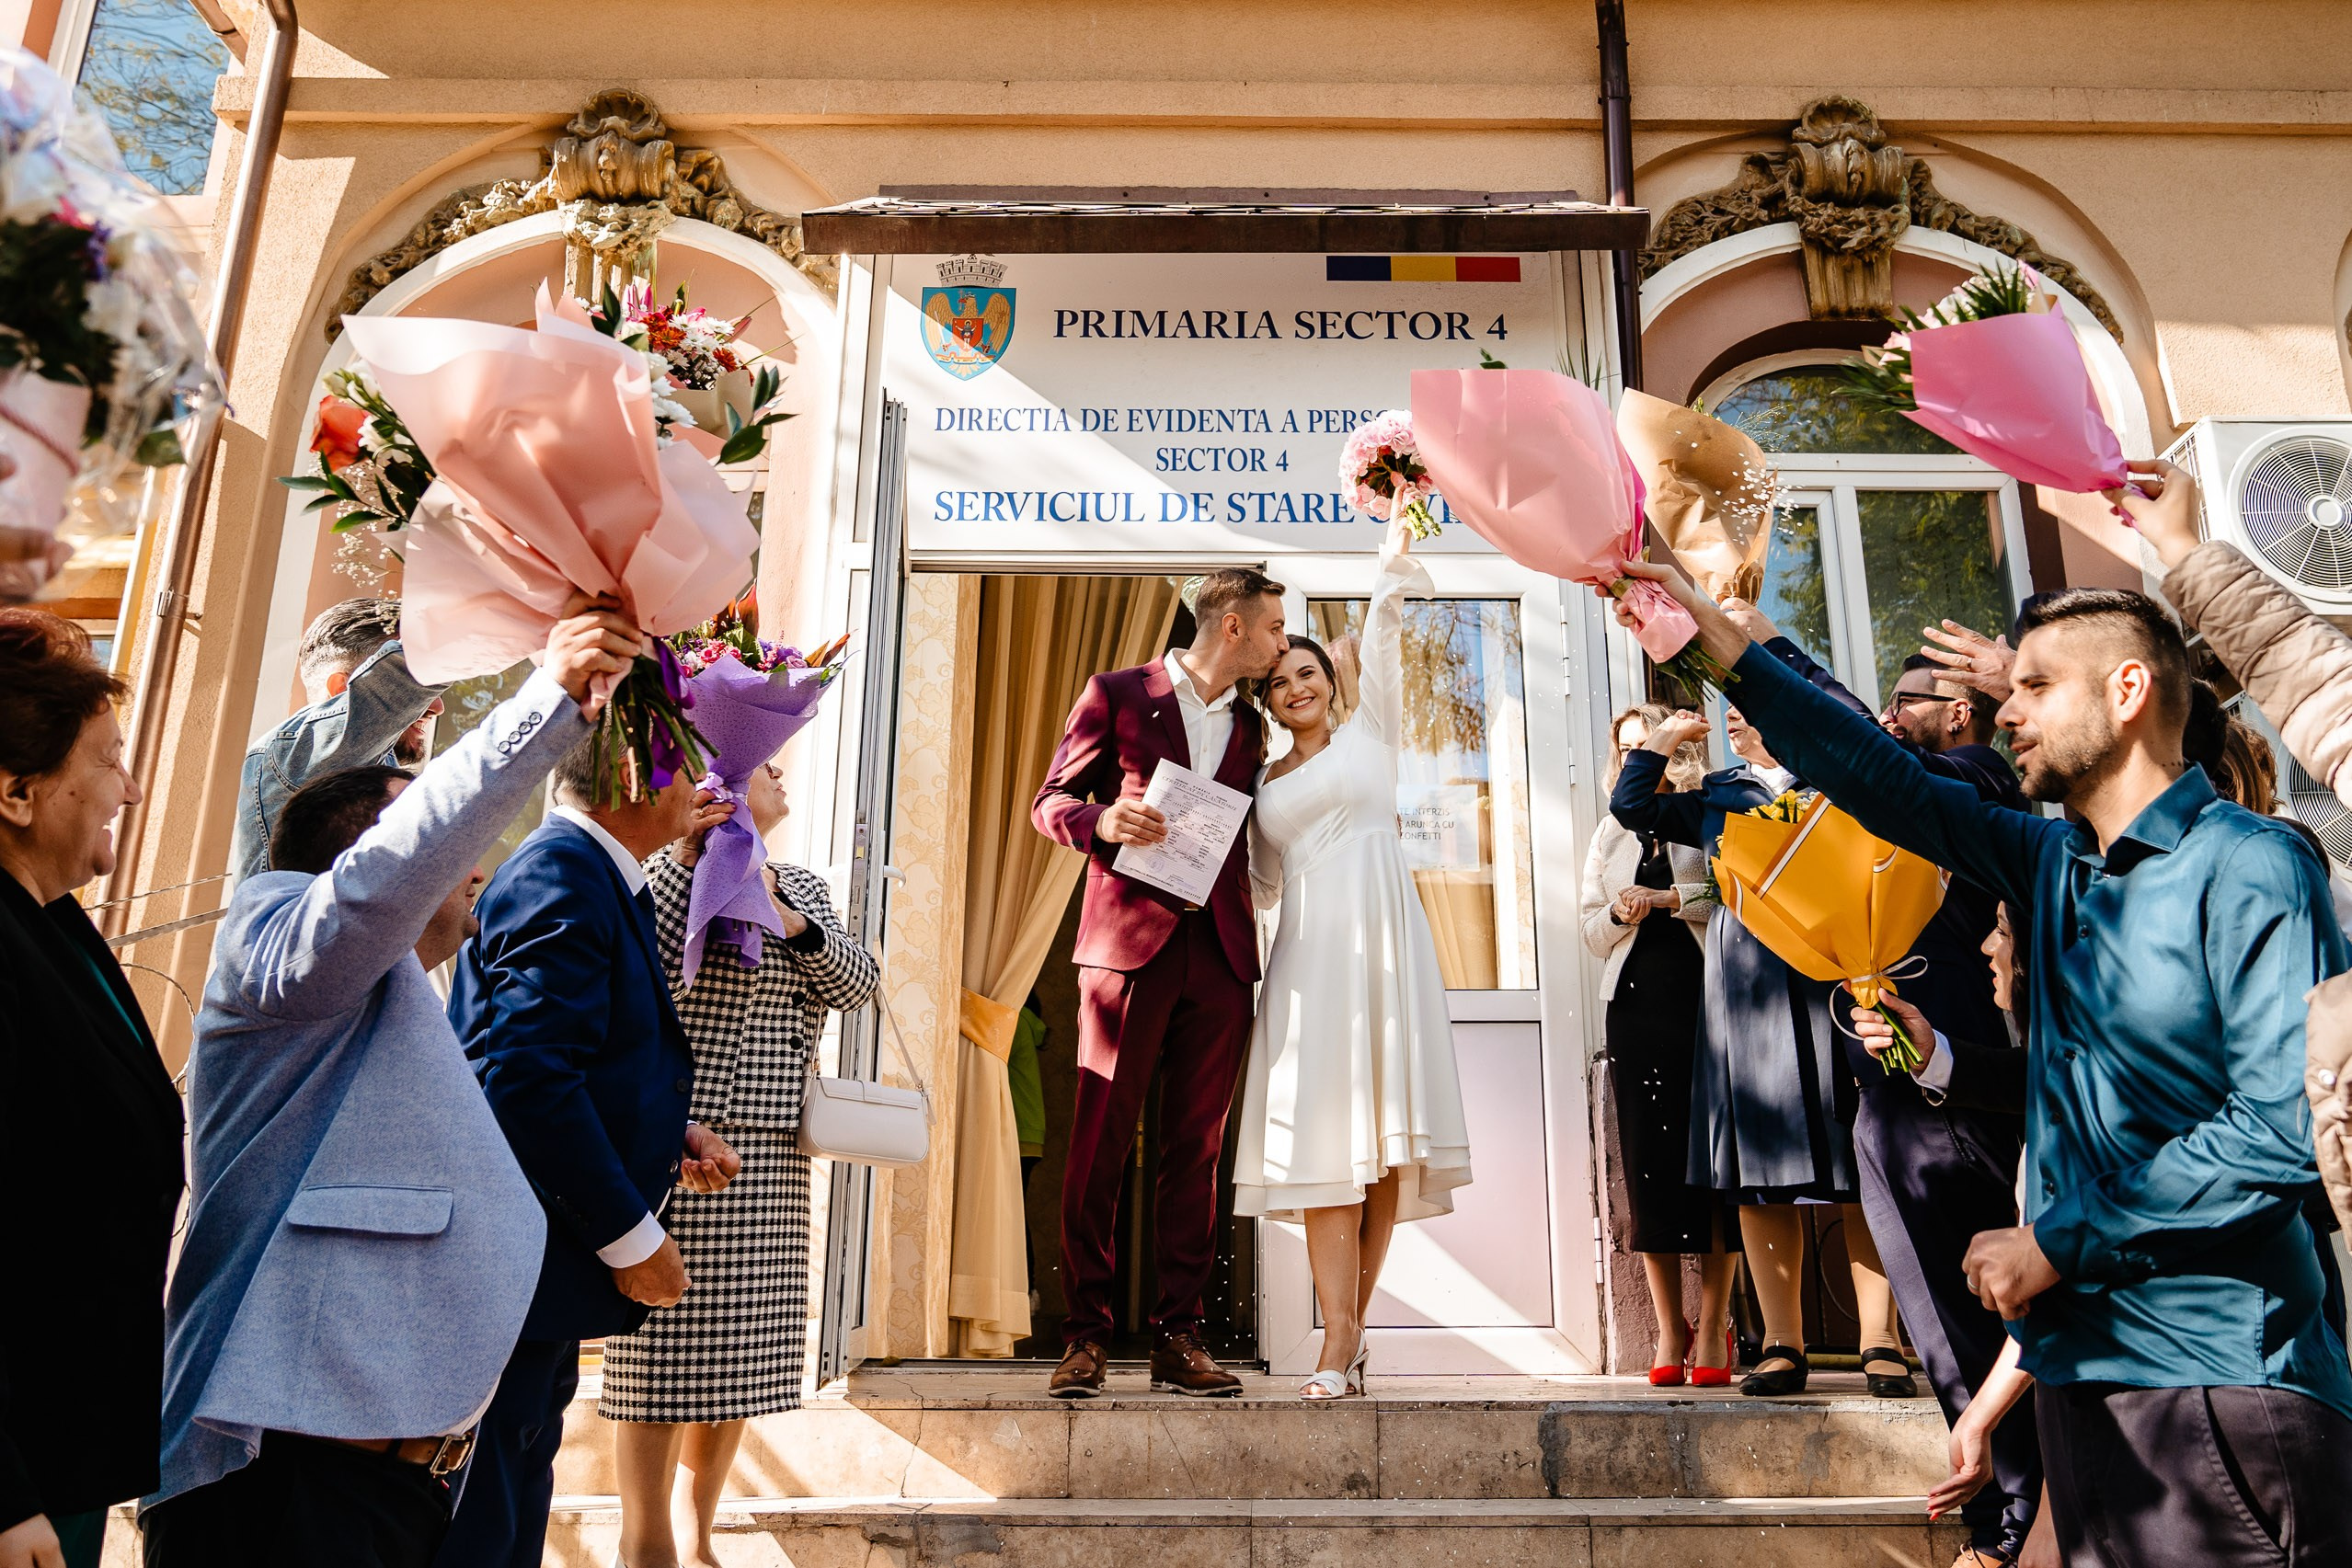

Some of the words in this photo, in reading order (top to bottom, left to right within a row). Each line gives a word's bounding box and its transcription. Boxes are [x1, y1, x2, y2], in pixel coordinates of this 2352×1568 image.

[1052, 308, 1284, 339] PRIMARIA
[1294, 310, 1476, 341] SECTOR
[1486, 313, 1509, 341] 4
[934, 407, 1073, 432] DIRECTIA
[1079, 407, 1119, 432] DE
[1126, 408, 1274, 433] EVIDENTA
[1279, 408, 1302, 433] A
[1155, 447, 1269, 473] SECTOR
[1275, 449, 1290, 473] 4
[934, 491, 1146, 522] SERVICIUL
[1157, 492, 1216, 522] DE
[1226, 492, 1355, 523] STARE
[1405, 819, 1440, 829] ARUNCA
[1441, 820, 1455, 829] CU
[1412, 807, 1451, 817] INTERZIS
